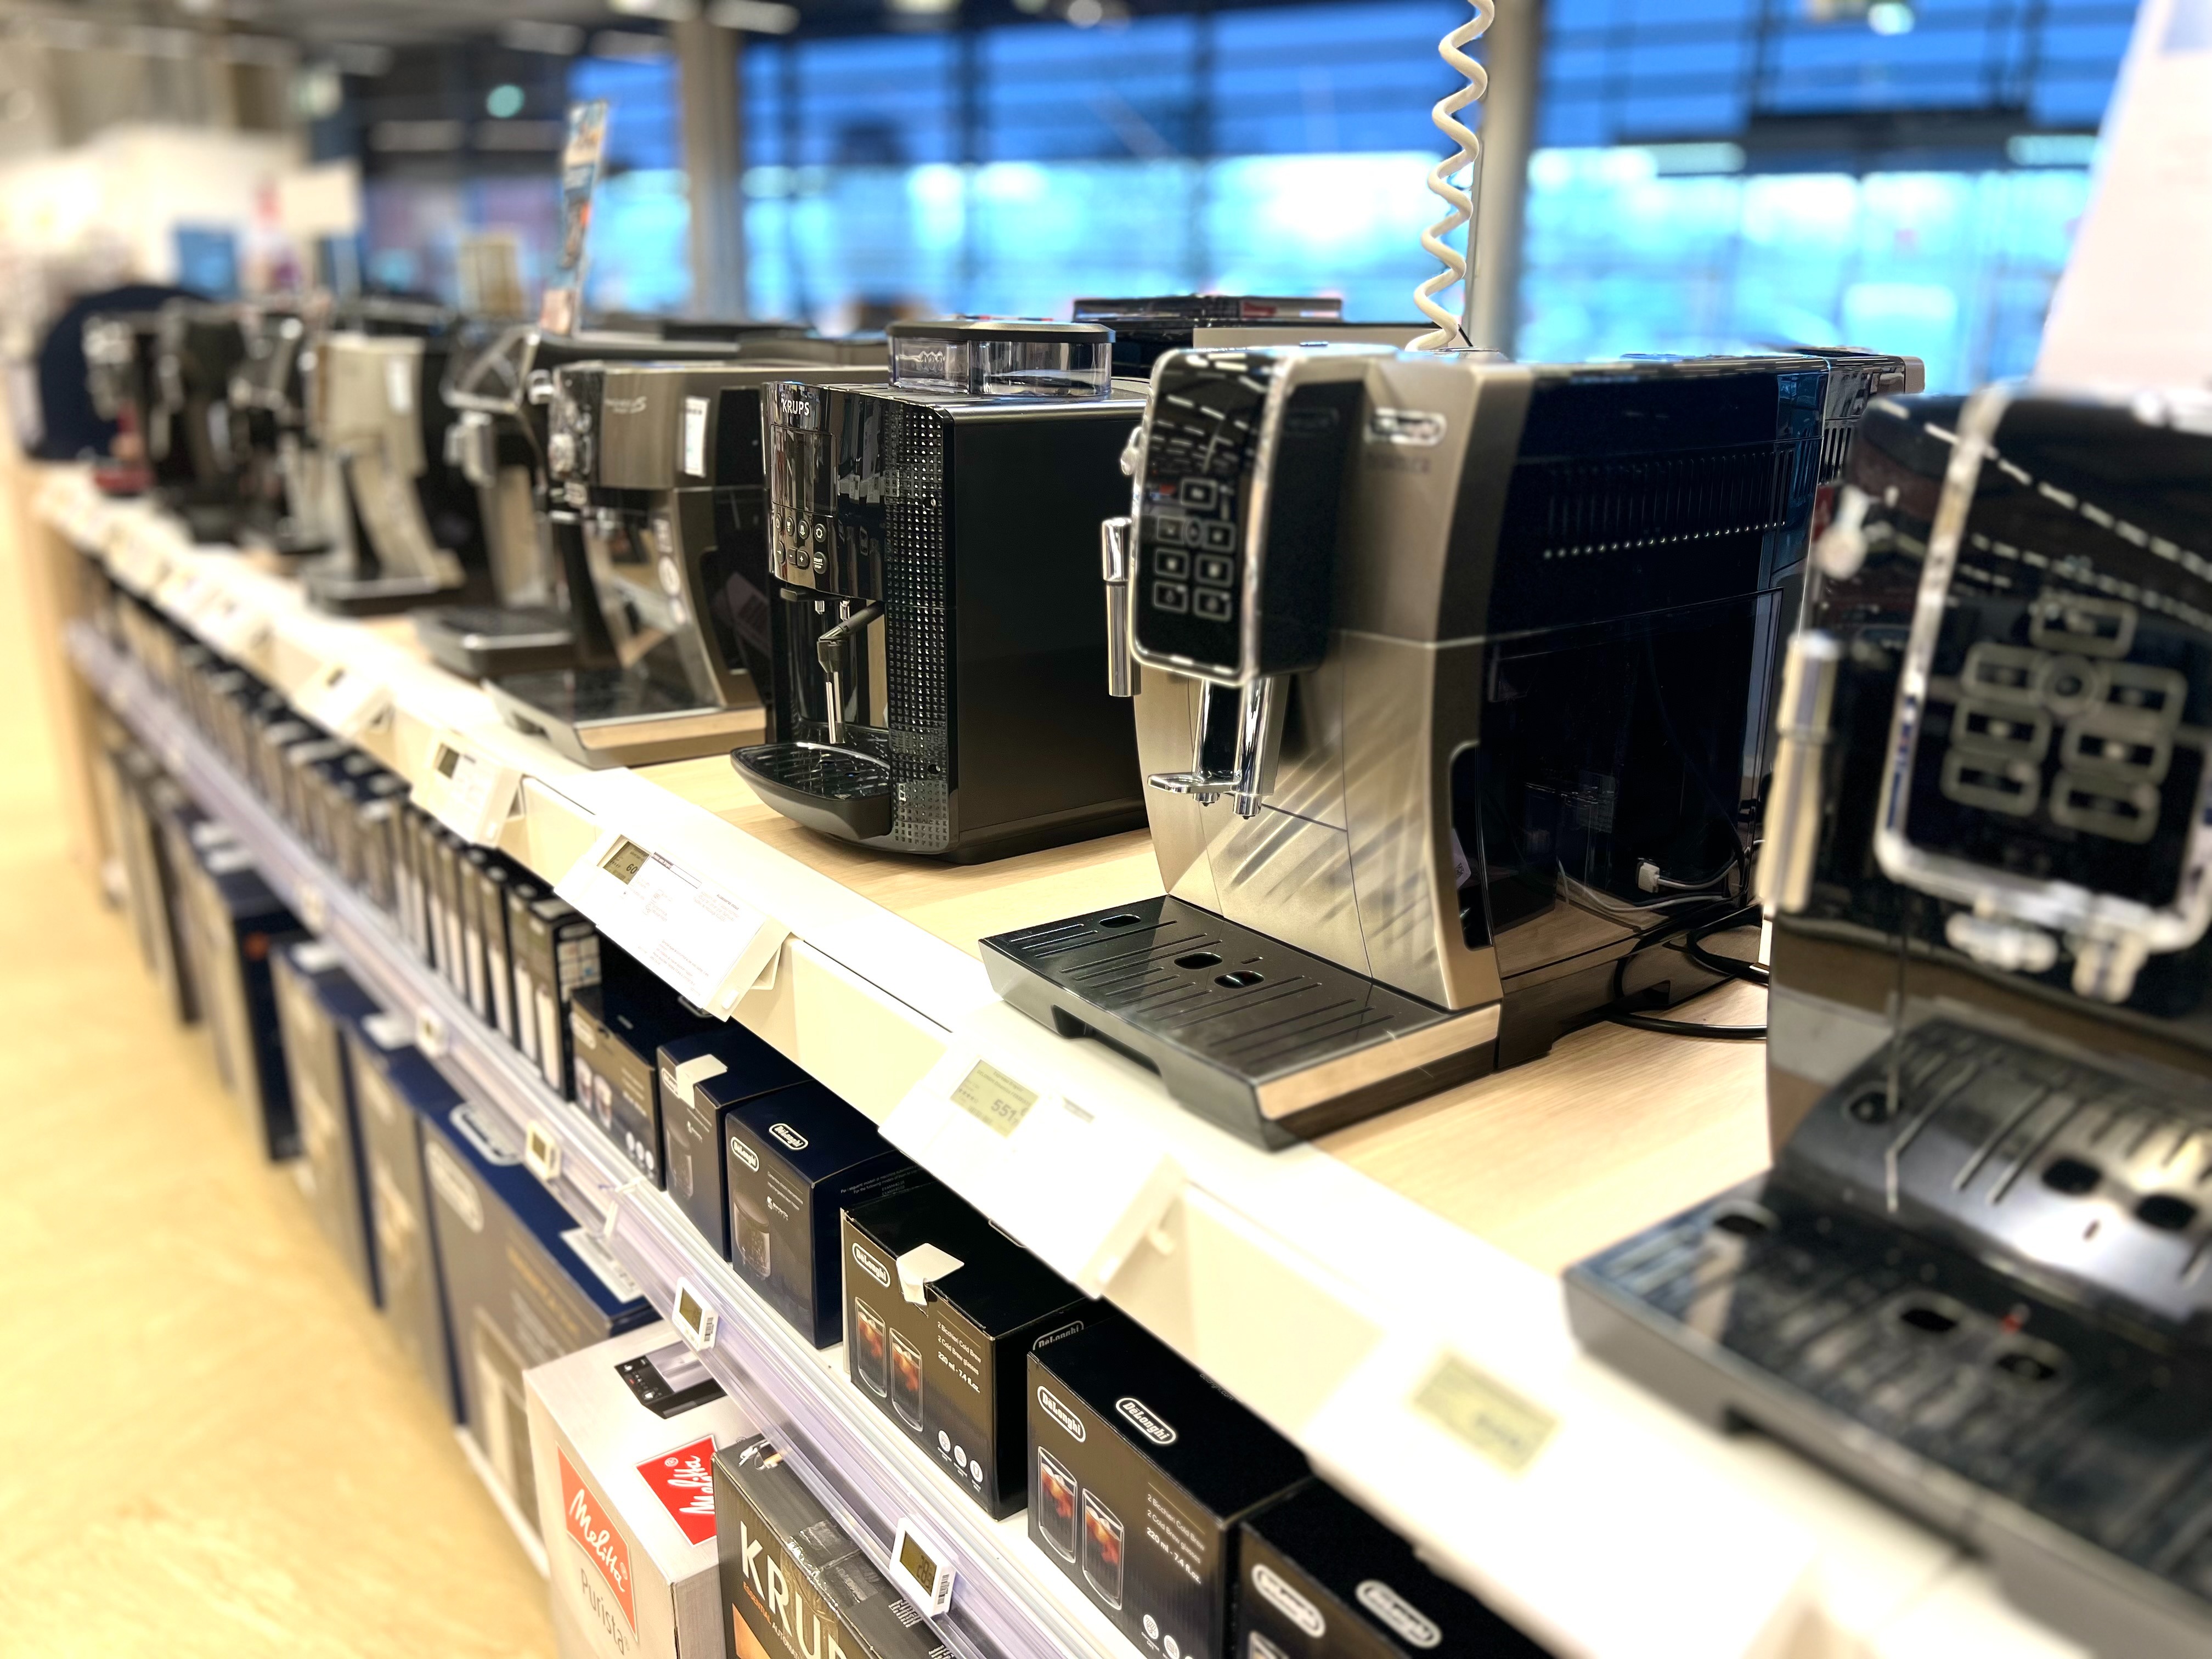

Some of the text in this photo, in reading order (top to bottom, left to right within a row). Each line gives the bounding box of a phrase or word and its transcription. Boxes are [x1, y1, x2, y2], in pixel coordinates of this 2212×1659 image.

[781, 397, 810, 416] KRUPS
[938, 1351, 948, 1365] 220
[949, 1362, 955, 1371] ml
[958, 1369, 967, 1382] 7.4
[941, 1339, 951, 1351] Cold
[952, 1347, 963, 1361] Brew
[963, 1358, 979, 1375] glasses
[959, 1340, 969, 1353] Cold
[970, 1348, 981, 1363] Brew
[569, 1488, 625, 1593] Melitta
[1147, 1494, 1204, 1551] 2 Bicchieri Cold Brew
[1147, 1509, 1200, 1564] 2 Cold Brew glasses
[1147, 1527, 1159, 1543] 220
[1160, 1542, 1169, 1553] ml
[1174, 1552, 1184, 1567] 7.4
[581, 1567, 625, 1656] Purista
